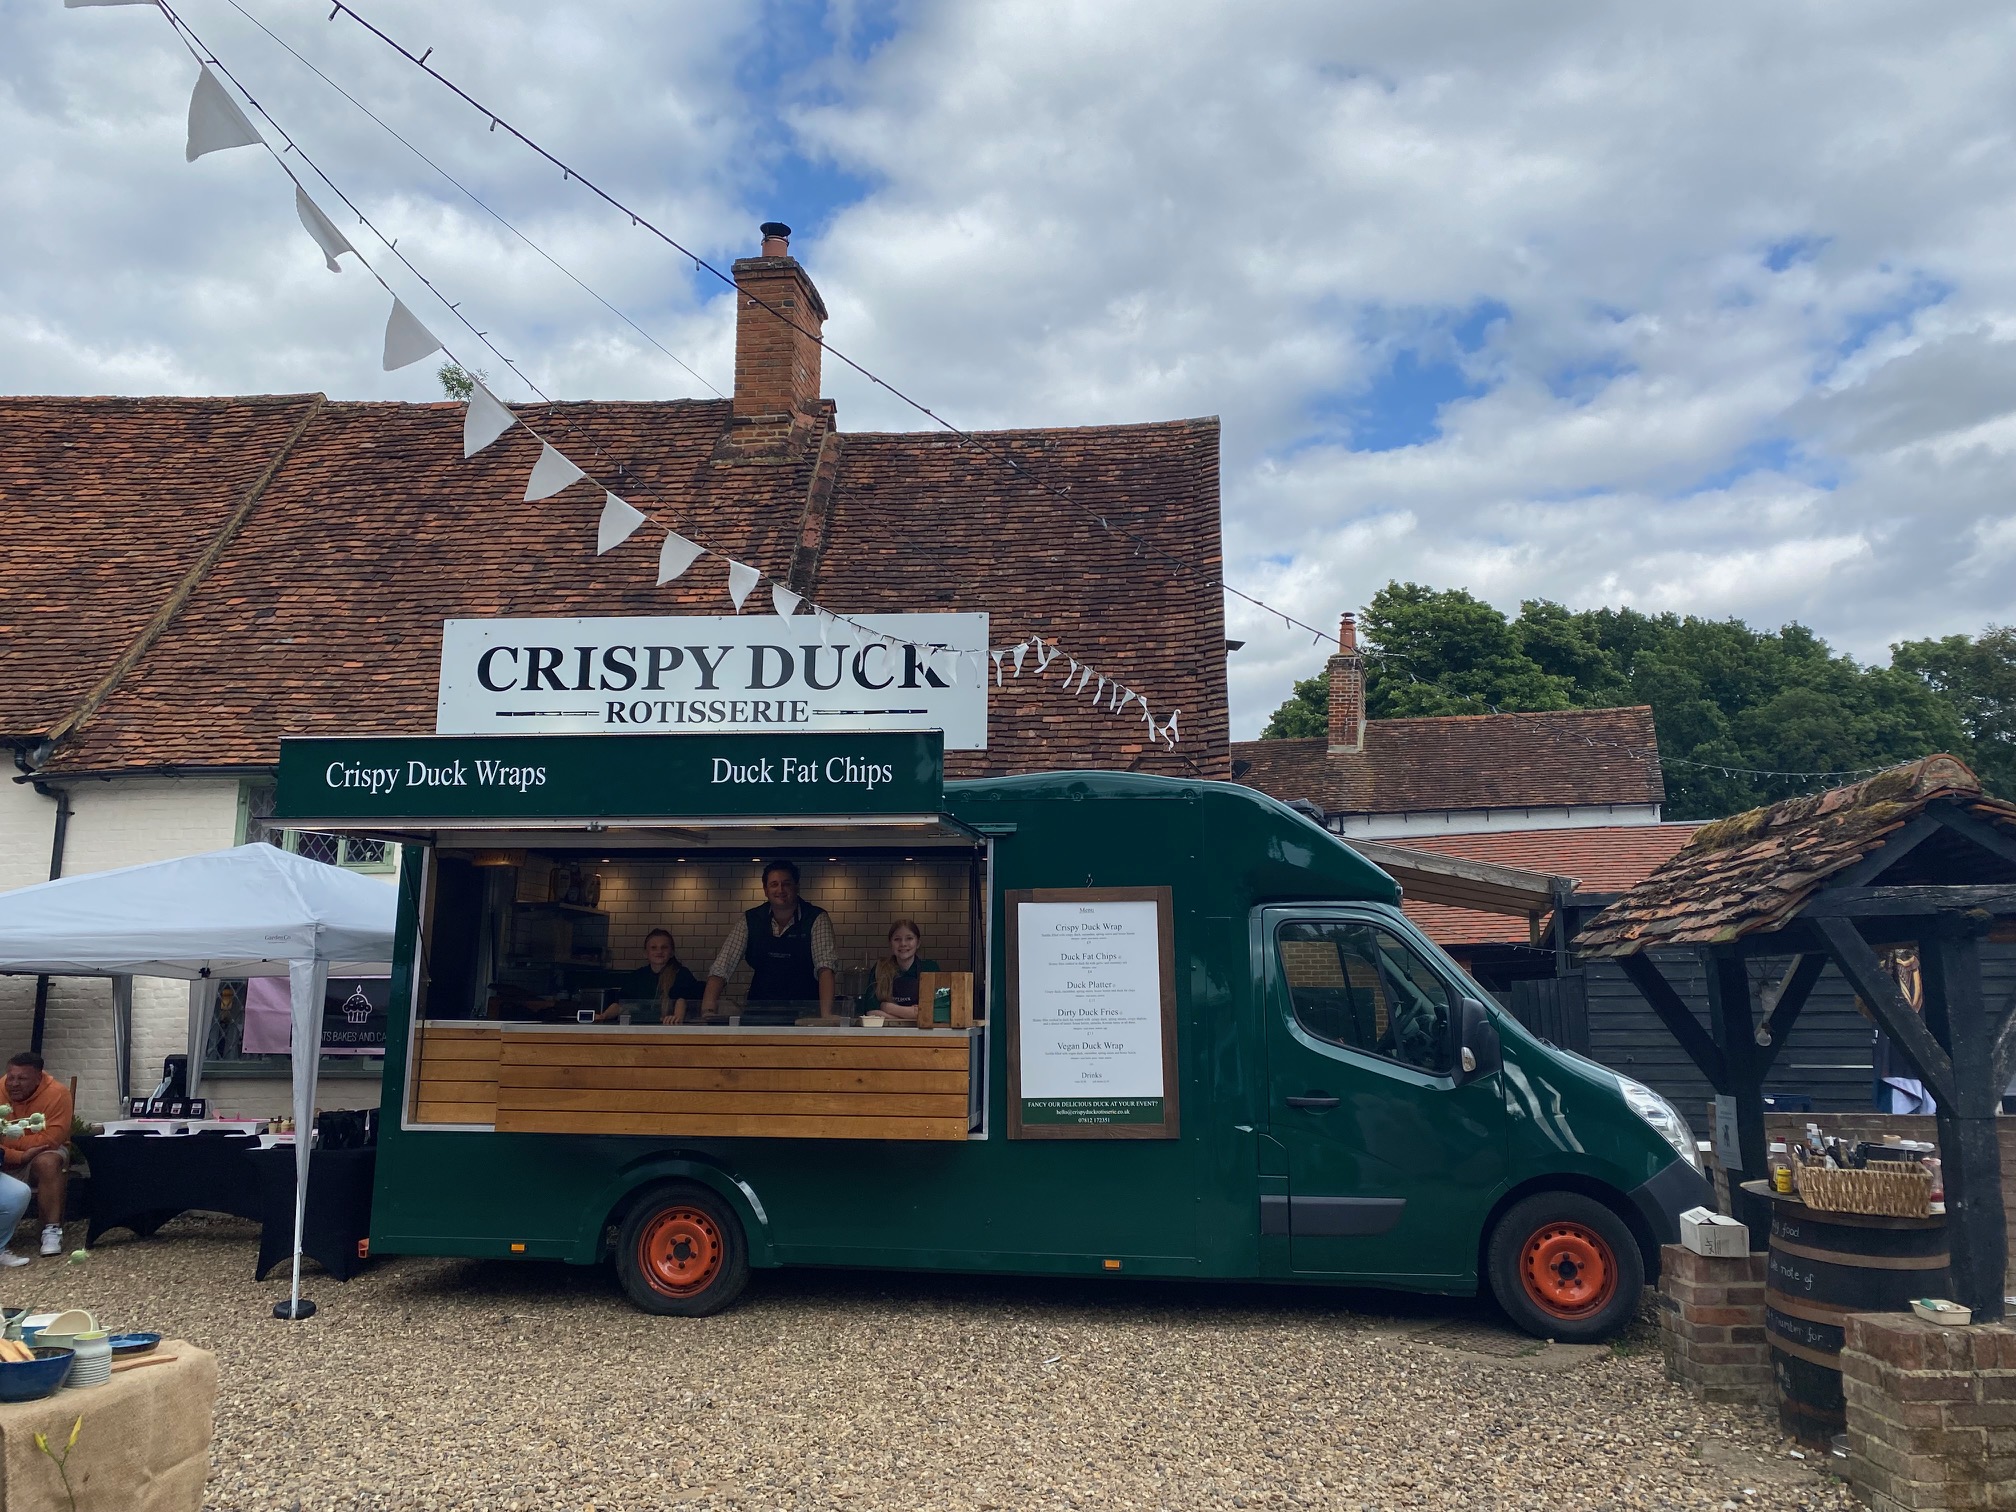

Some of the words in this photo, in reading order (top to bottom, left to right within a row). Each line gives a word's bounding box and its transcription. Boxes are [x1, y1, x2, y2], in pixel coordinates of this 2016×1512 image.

[477, 645, 735, 692] CRISPY
[745, 643, 950, 691] DUCK
[604, 700, 809, 724] ROTISSERIE
[325, 760, 401, 794] Crispy
[406, 759, 468, 787] Duck
[474, 759, 546, 793] Wraps
[711, 757, 775, 784] Duck
[780, 757, 819, 784] Fat
[825, 756, 893, 791] Chips
[1079, 906, 1095, 914] Menu
[1055, 923, 1079, 933] Crispy
[1081, 923, 1101, 931] Duck
[1102, 922, 1123, 932] Wrap
[1060, 953, 1080, 961] Duck
[1082, 952, 1094, 961] Fat
[1095, 952, 1117, 961] Chips
[1066, 981, 1087, 989] Duck
[1088, 980, 1112, 989] Platter
[1057, 1008, 1077, 1018] Dirty
[1078, 1008, 1099, 1016] Duck
[1100, 1008, 1119, 1016] Fries
[321, 1031, 332, 1042] TS
[332, 1031, 357, 1042] BAKES
[359, 1031, 375, 1042] AND
[1057, 1042, 1080, 1051] Vegan
[1082, 1042, 1102, 1050] Duck
[1104, 1041, 1124, 1051] Wrap
[1081, 1071, 1103, 1079] Drinks
[1780, 1222, 1800, 1238] food
[1780, 1265, 1800, 1281] note
[1804, 1273, 1815, 1291] of
[1807, 1326, 1824, 1343] for
